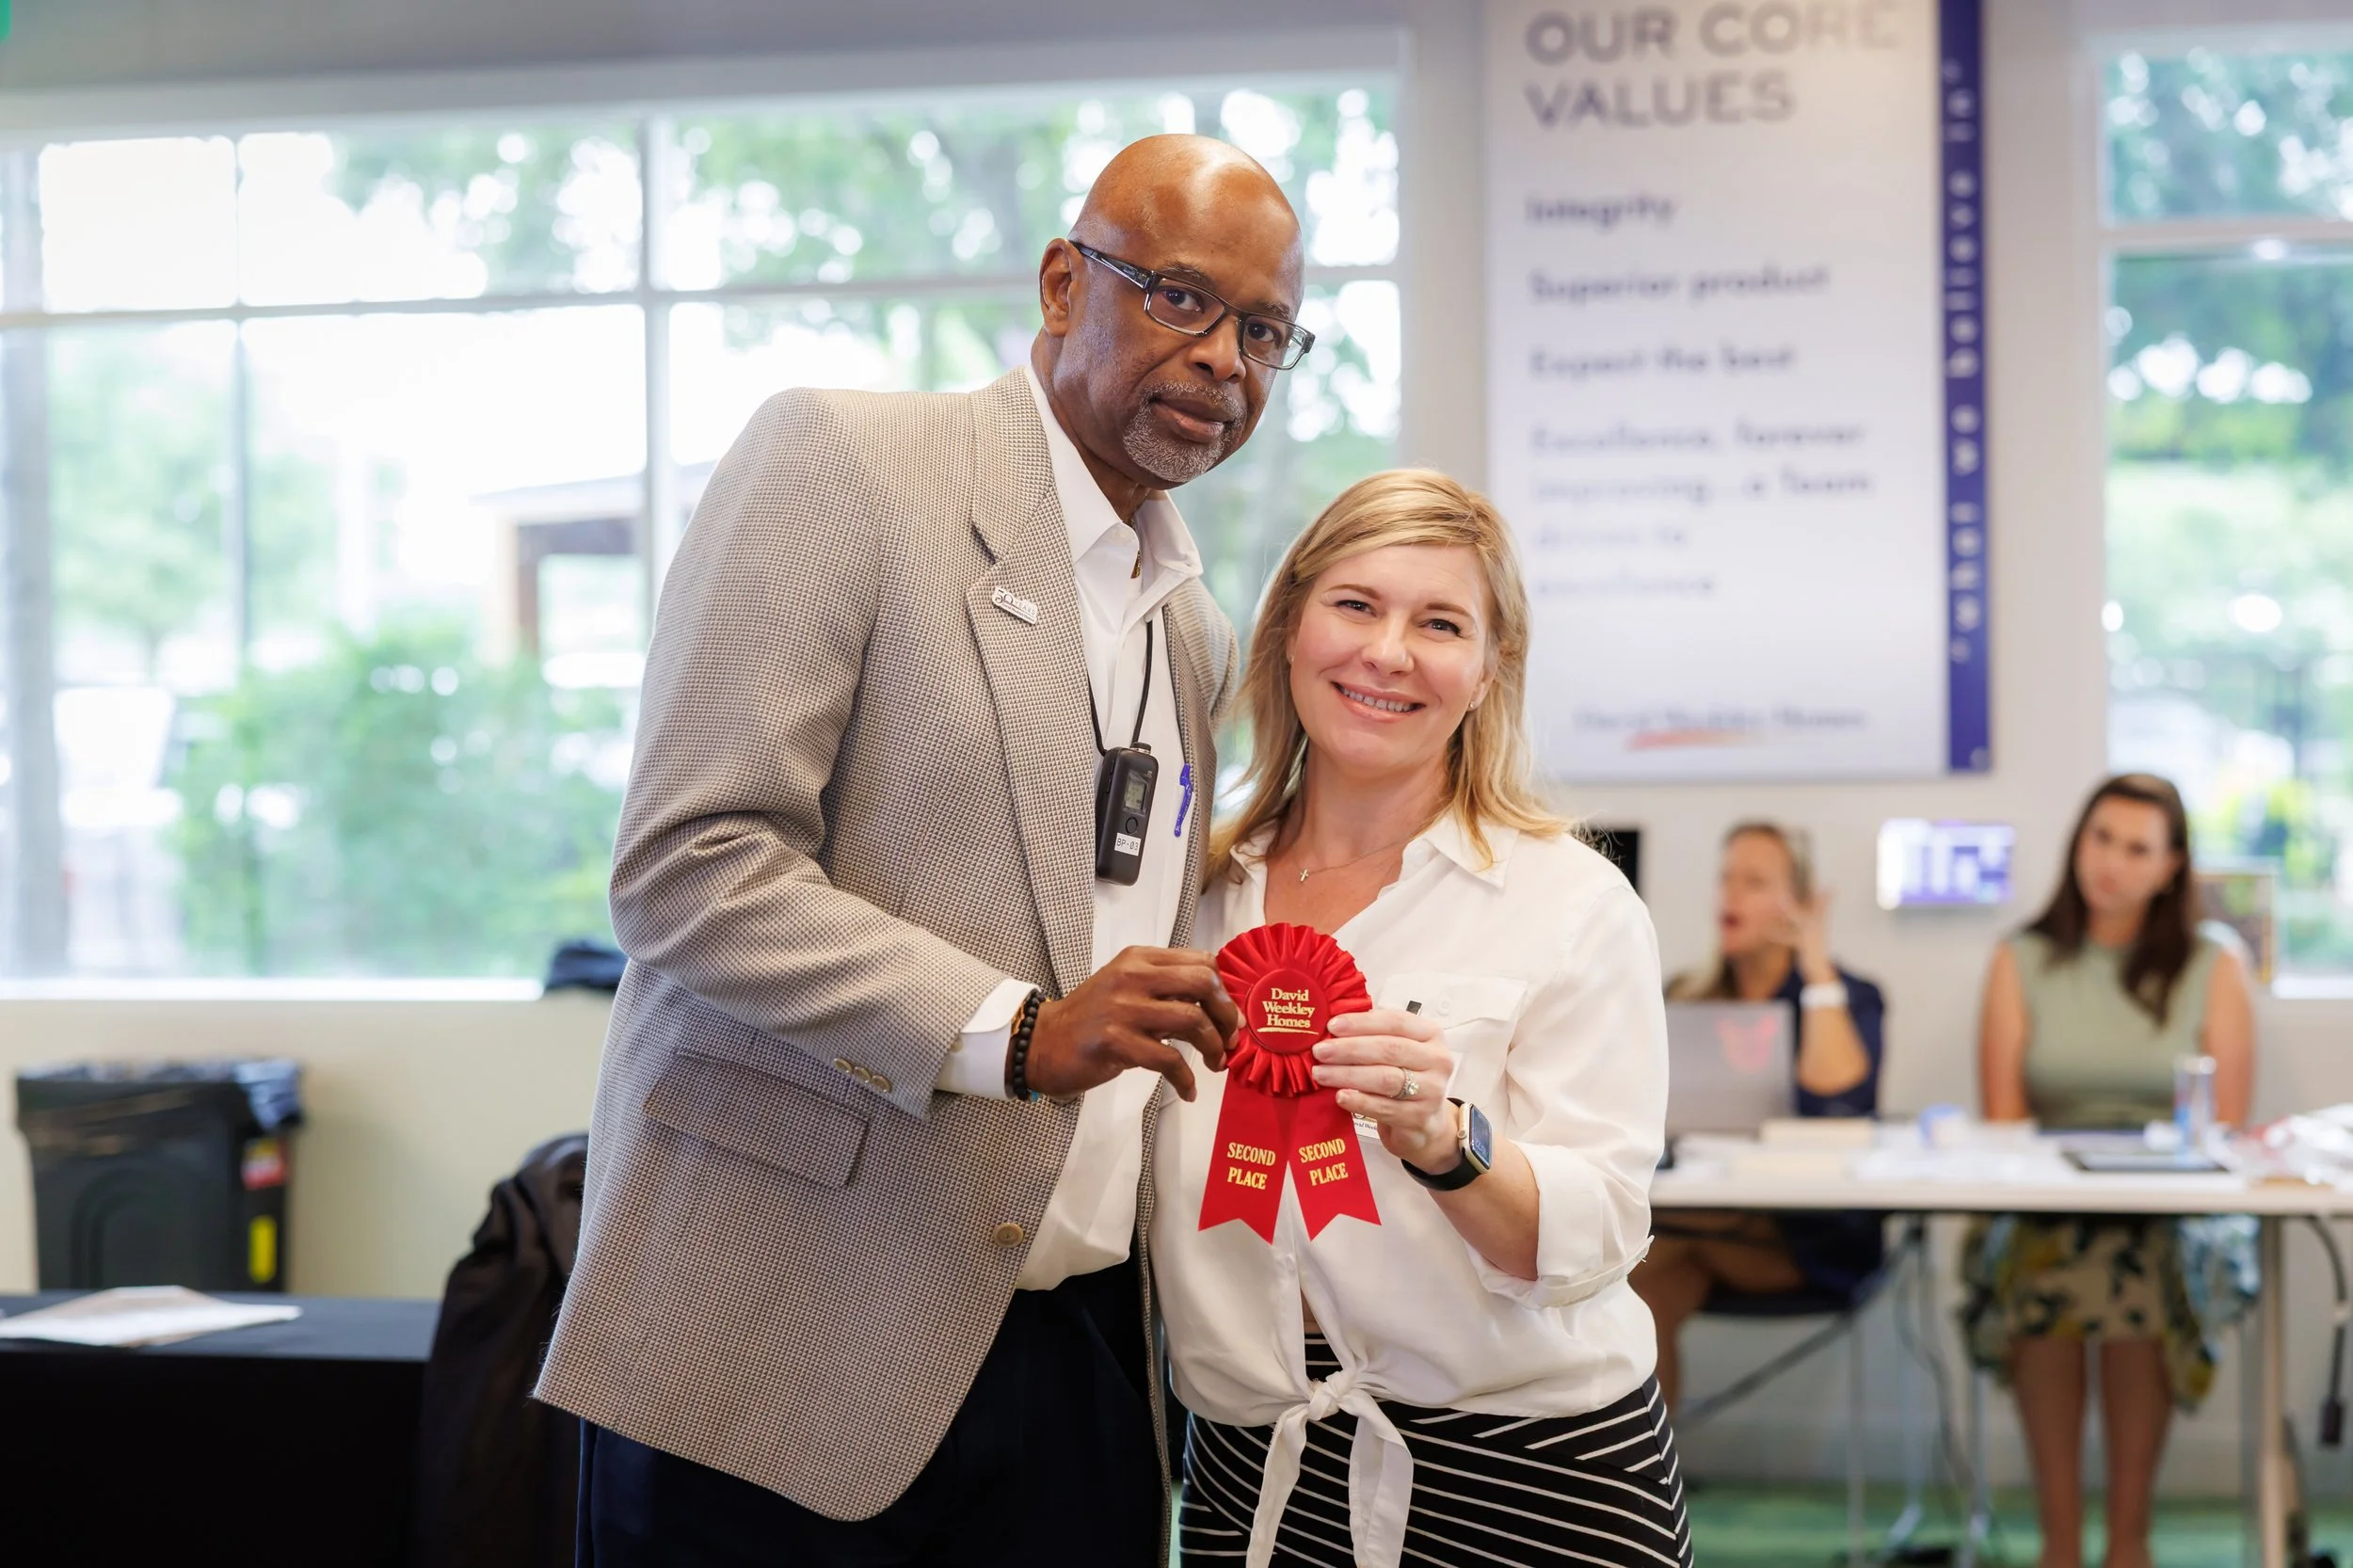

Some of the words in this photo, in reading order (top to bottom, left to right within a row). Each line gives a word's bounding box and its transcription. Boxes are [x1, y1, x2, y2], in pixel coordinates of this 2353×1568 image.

[1524, 8, 1679, 66] OUR
[1698, 2, 1901, 58] CORE
[1522, 69, 1798, 131] VALUES
[1271, 987, 1310, 1002] David
[1262, 1000, 1316, 1018] Weekley
[1266, 1014, 1311, 1029] Homes
[1226, 1142, 1276, 1167] SECOND
[1298, 1138, 1346, 1163] SECOND
[1226, 1166, 1268, 1190] PLACE
[1308, 1162, 1349, 1186] PLACE
